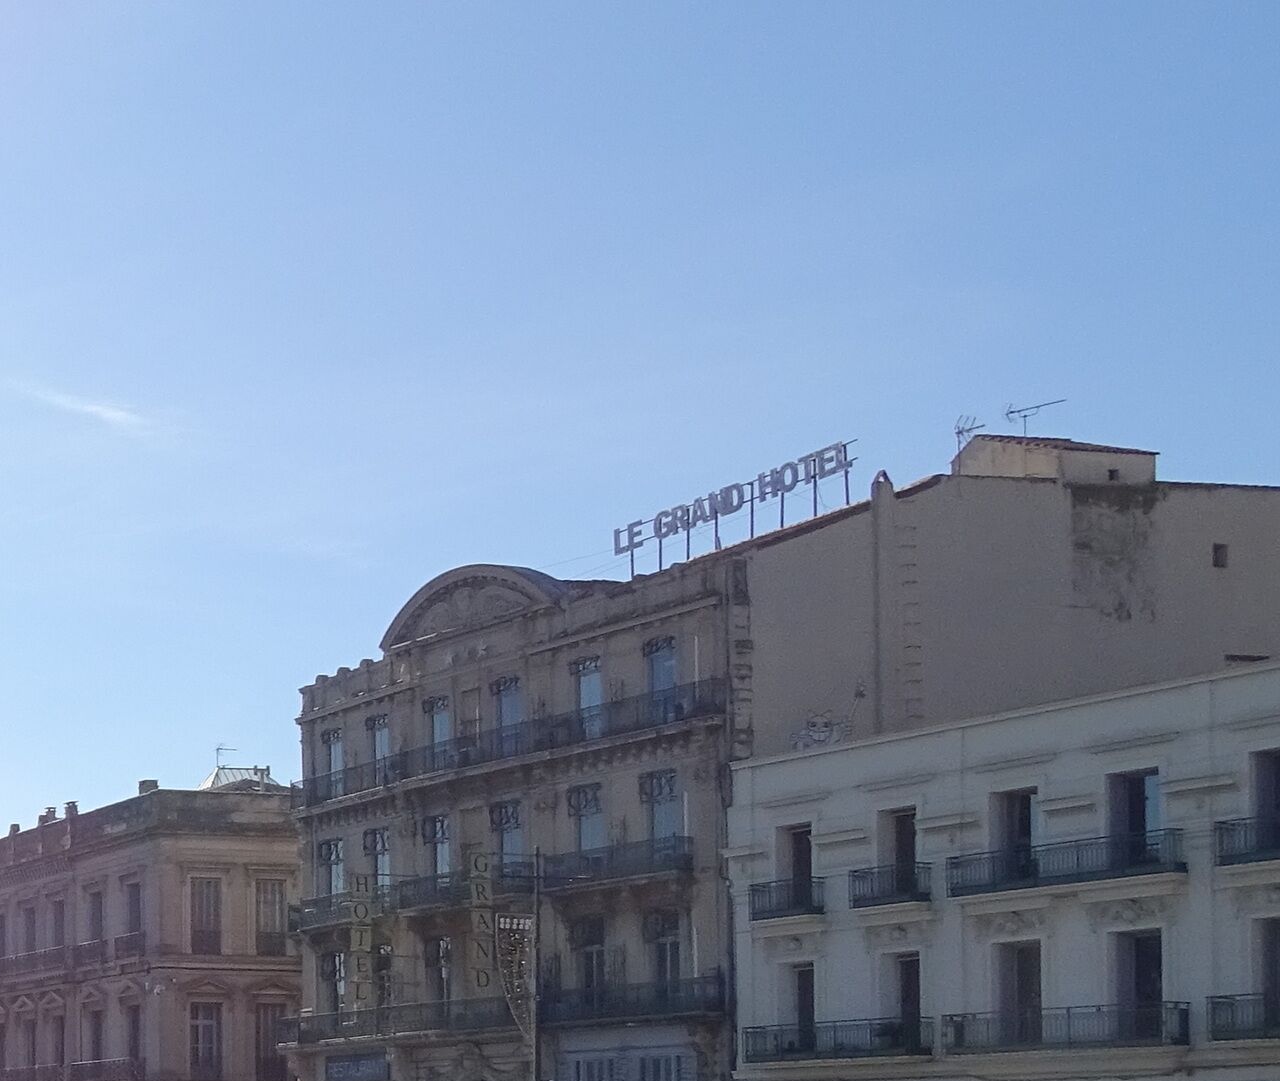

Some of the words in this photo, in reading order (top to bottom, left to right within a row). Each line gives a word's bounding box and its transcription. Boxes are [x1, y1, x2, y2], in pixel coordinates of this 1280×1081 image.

[613, 519, 644, 556] LE
[653, 482, 745, 540] GRAND
[757, 441, 854, 503] HOTEL
[354, 875, 369, 1001] HOTEL
[473, 855, 490, 988] GRAND
